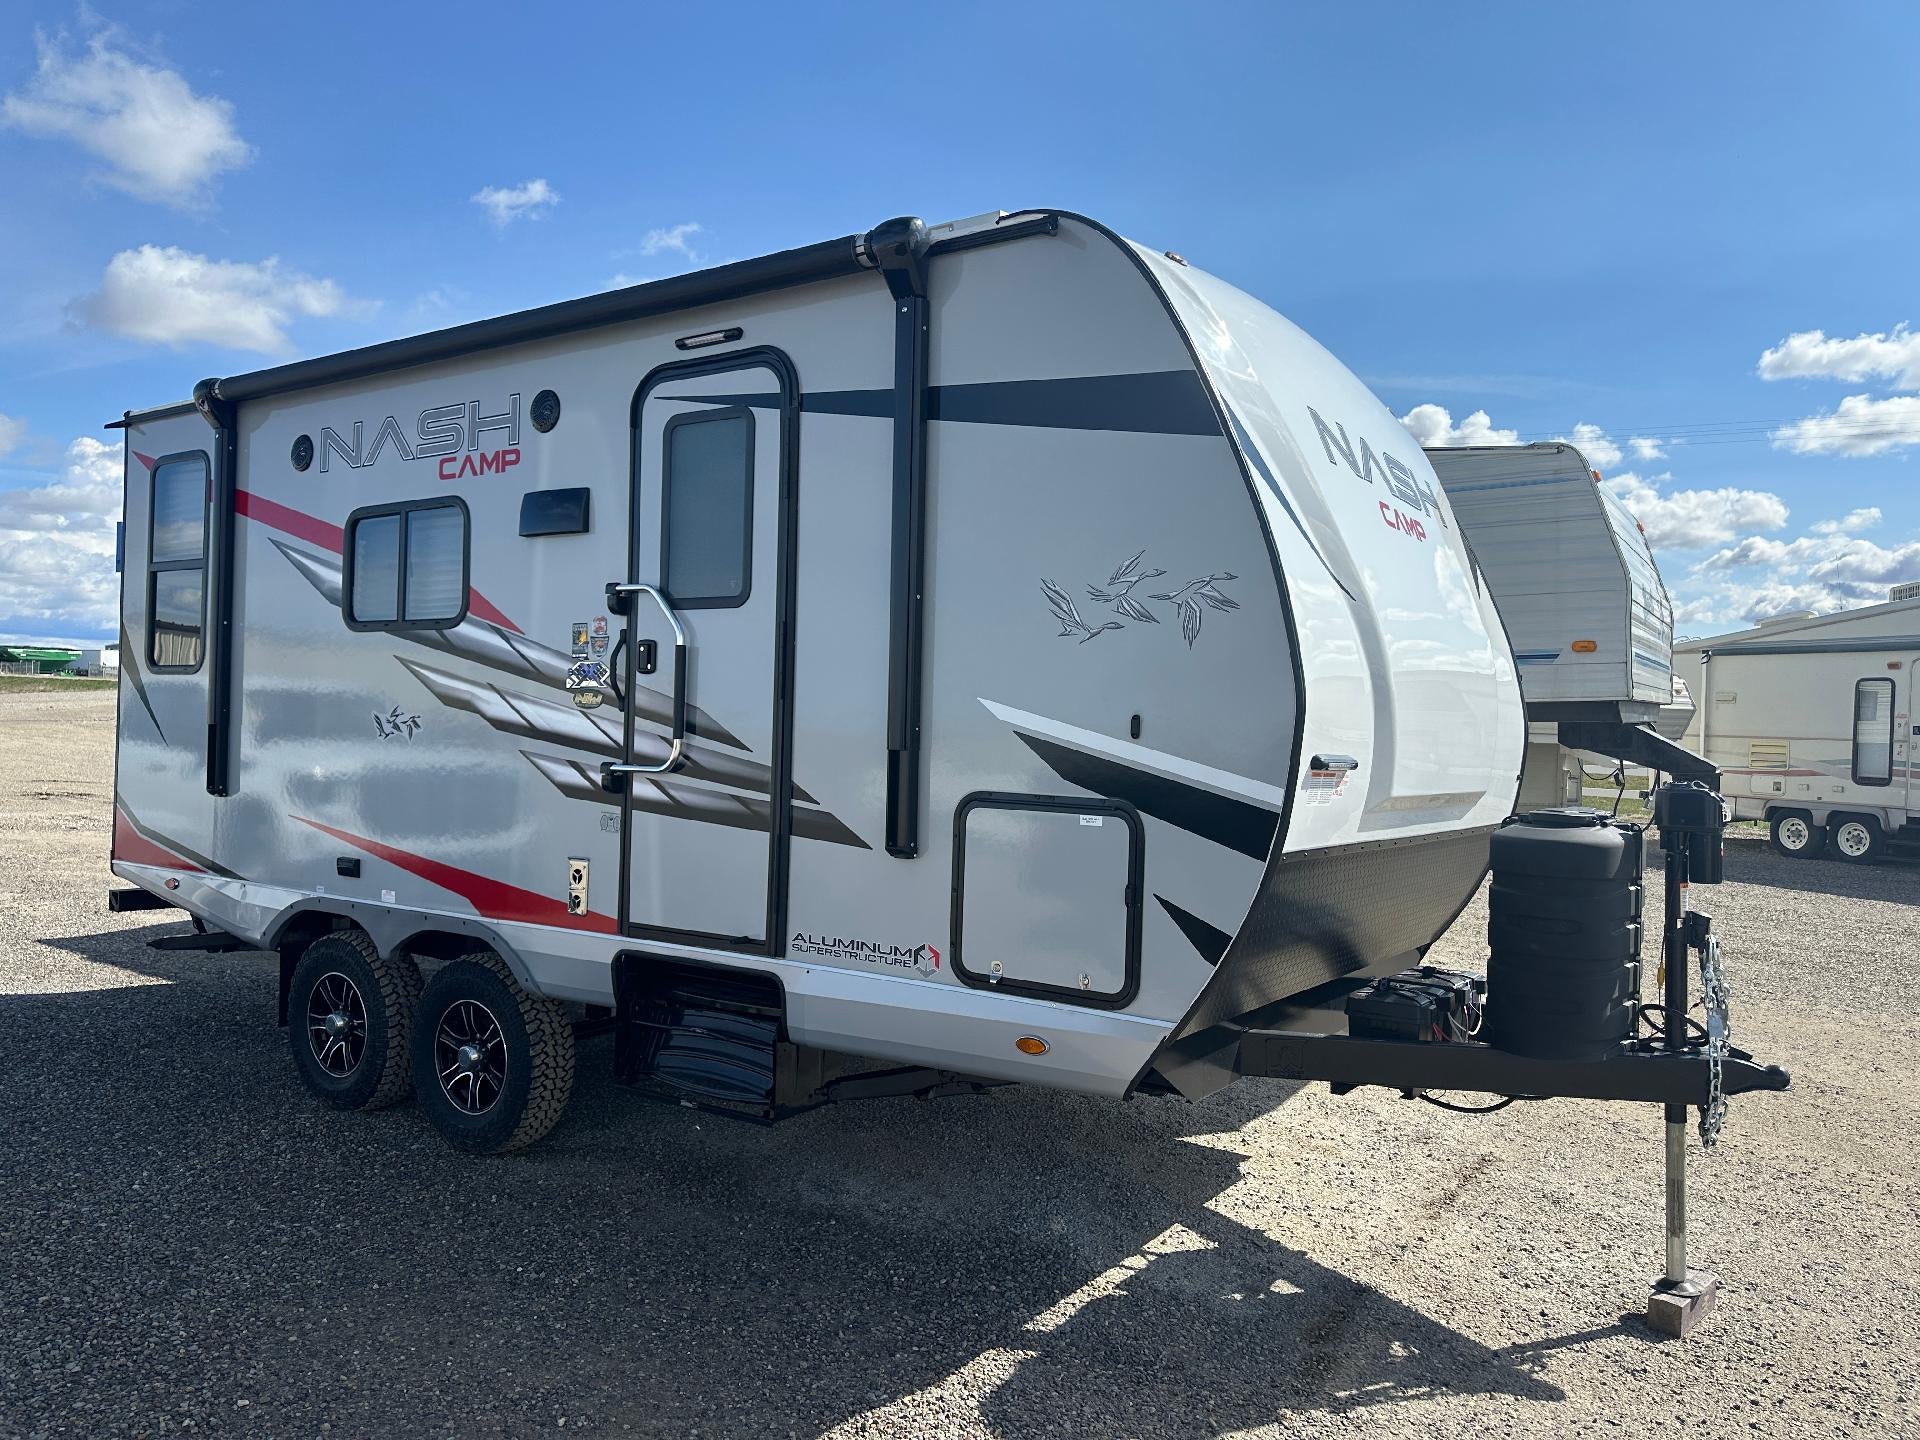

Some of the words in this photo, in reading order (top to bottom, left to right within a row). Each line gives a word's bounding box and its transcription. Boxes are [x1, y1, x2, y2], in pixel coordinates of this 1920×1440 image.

[319, 392, 521, 474] NASH
[438, 447, 521, 481] CAMP
[1306, 404, 1448, 530] NASH
[1378, 500, 1427, 543] CAMP
[791, 932, 913, 959] ALUMINUM
[791, 943, 912, 969] SUPERSTRUCTURE
